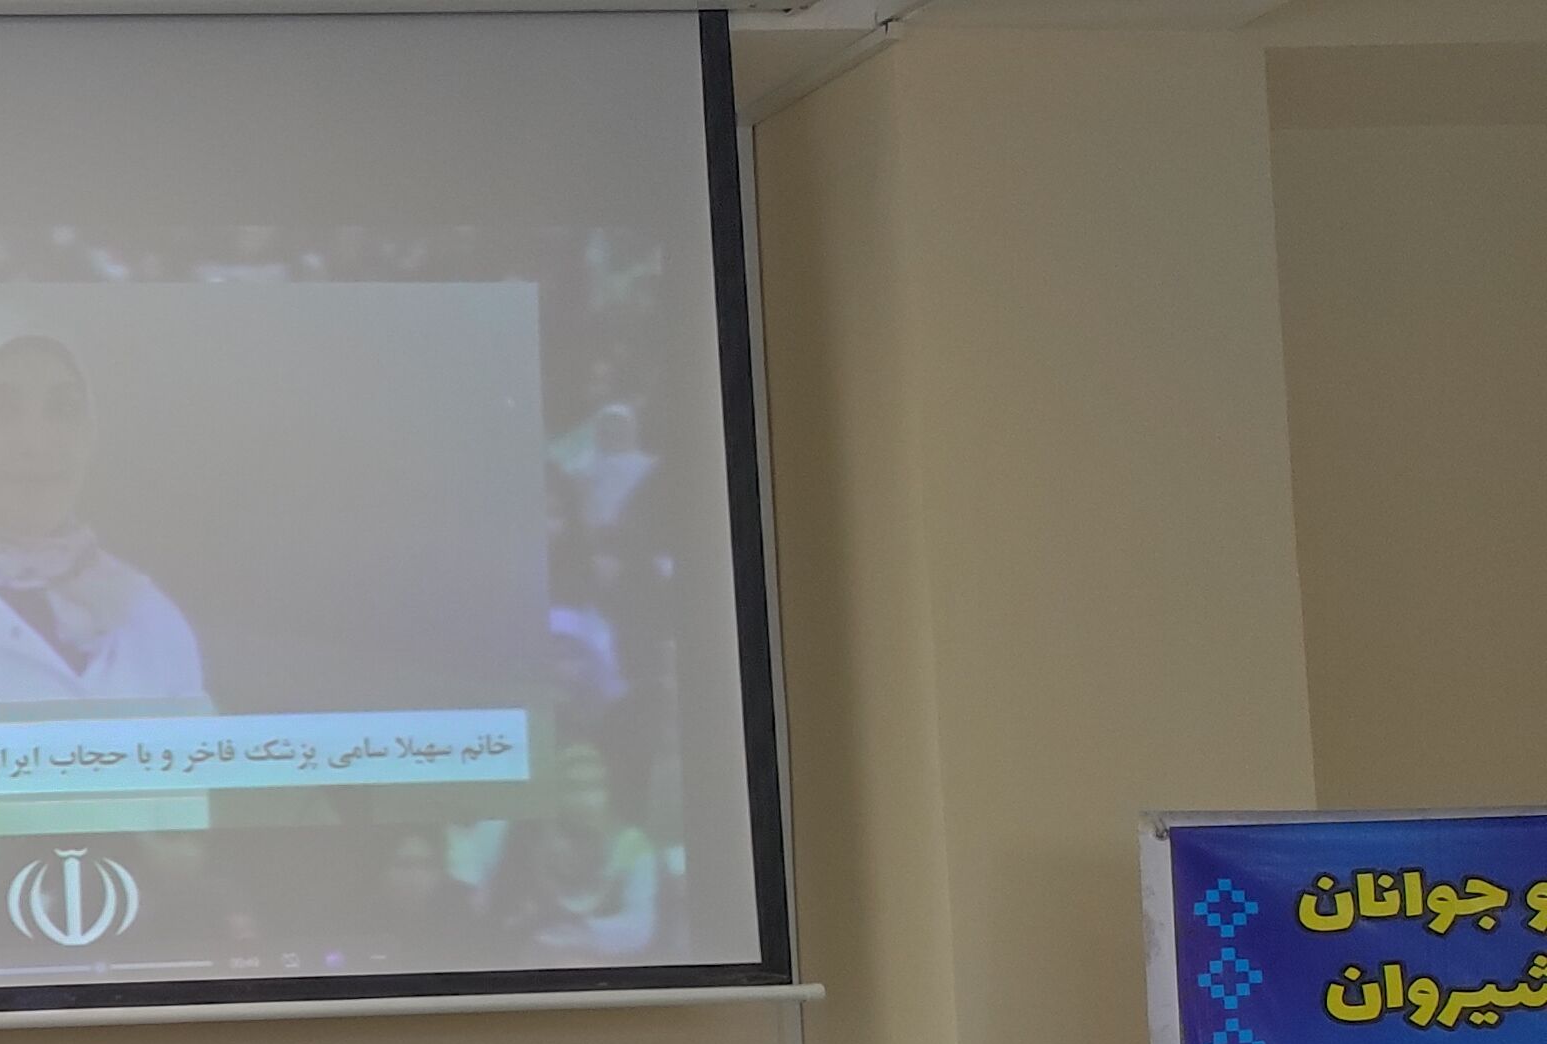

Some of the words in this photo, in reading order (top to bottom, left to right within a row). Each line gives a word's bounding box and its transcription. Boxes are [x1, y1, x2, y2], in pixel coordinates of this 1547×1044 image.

[48, 743, 127, 770] حجاب
[136, 742, 152, 768] با
[160, 749, 175, 773] و
[182, 739, 236, 774] فاخر
[244, 738, 317, 771] پزشک
[327, 736, 390, 770] سامی
[394, 735, 453, 761] سهیلا
[460, 733, 513, 762] خانم
[1296, 869, 1510, 936] جوانان
